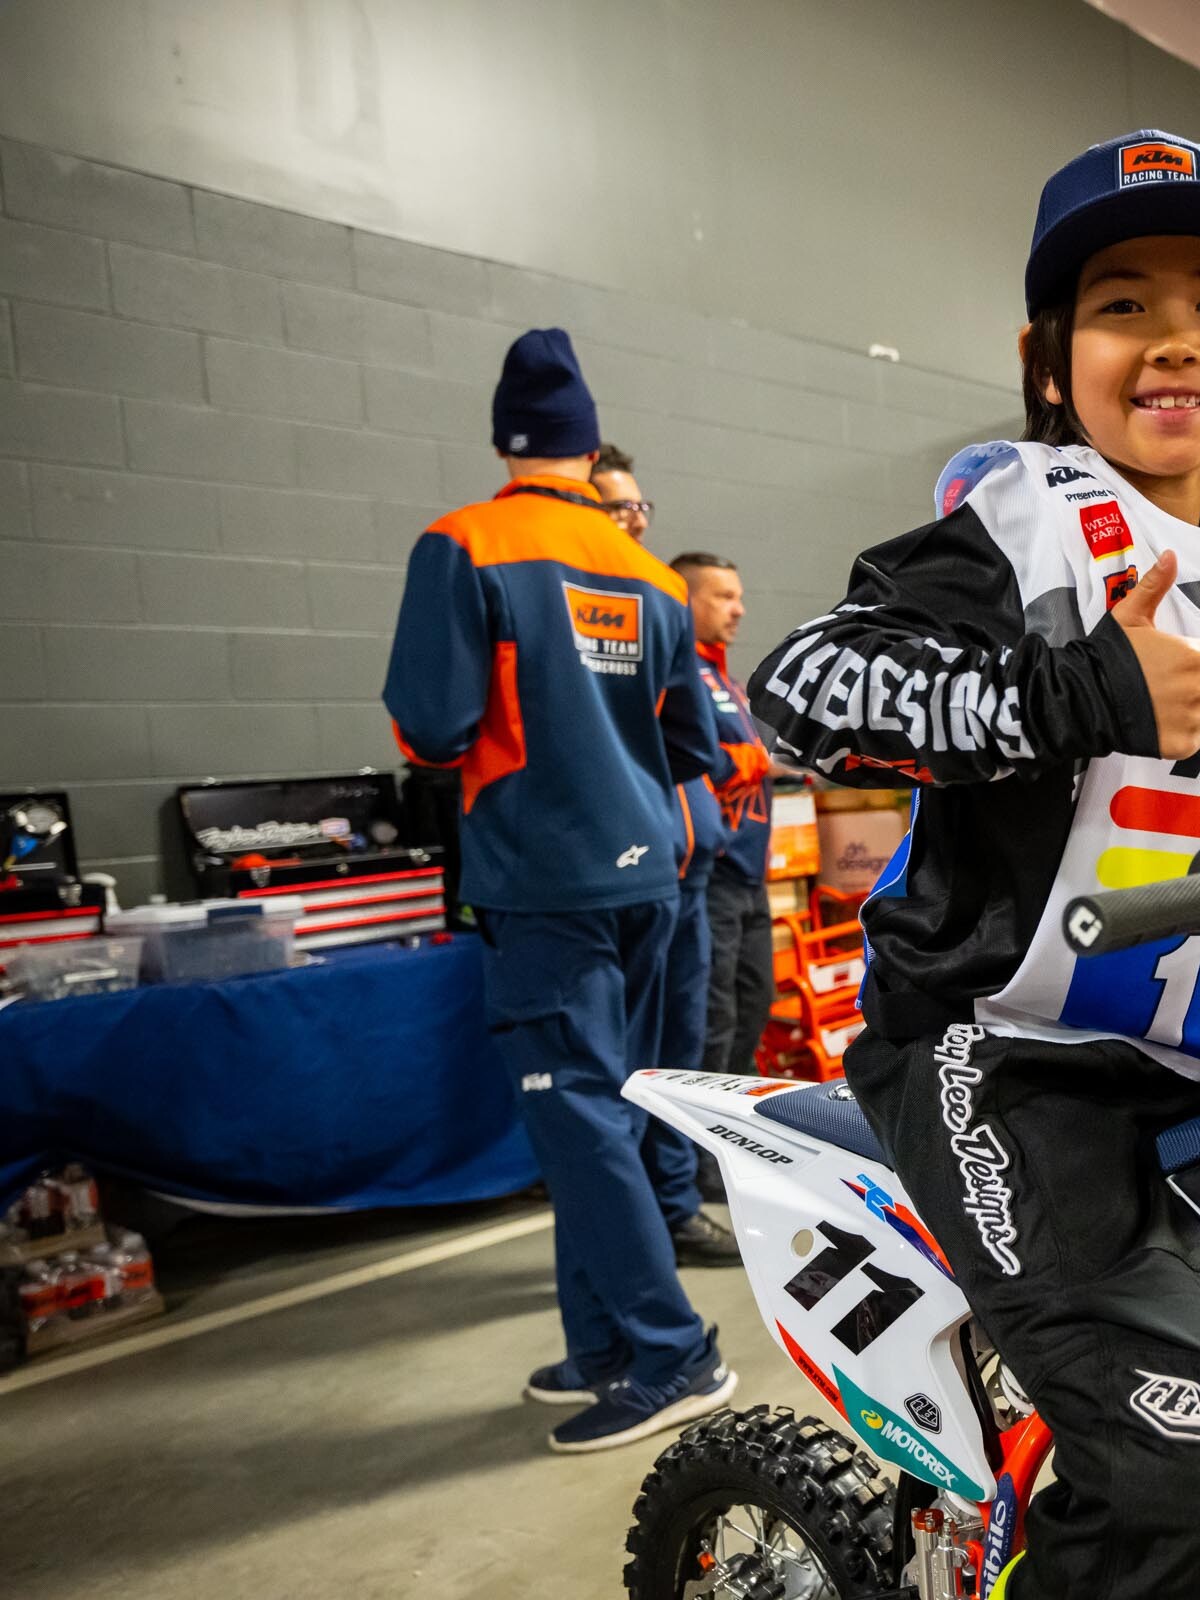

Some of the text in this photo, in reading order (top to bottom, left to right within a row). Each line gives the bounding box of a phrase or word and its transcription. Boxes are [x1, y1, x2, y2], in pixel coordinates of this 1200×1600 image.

[1124, 170, 1193, 185] RACING TEAM
[1133, 150, 1183, 166] KTM
[1091, 526, 1124, 544] FARO
[577, 606, 625, 628] KTM
[938, 1063, 983, 1133] Lee
[706, 1124, 793, 1165] DUNLOP
[950, 1124, 1021, 1276] Designs
[783, 1219, 926, 1356] 11
[880, 1420, 957, 1488] MOTOREX
